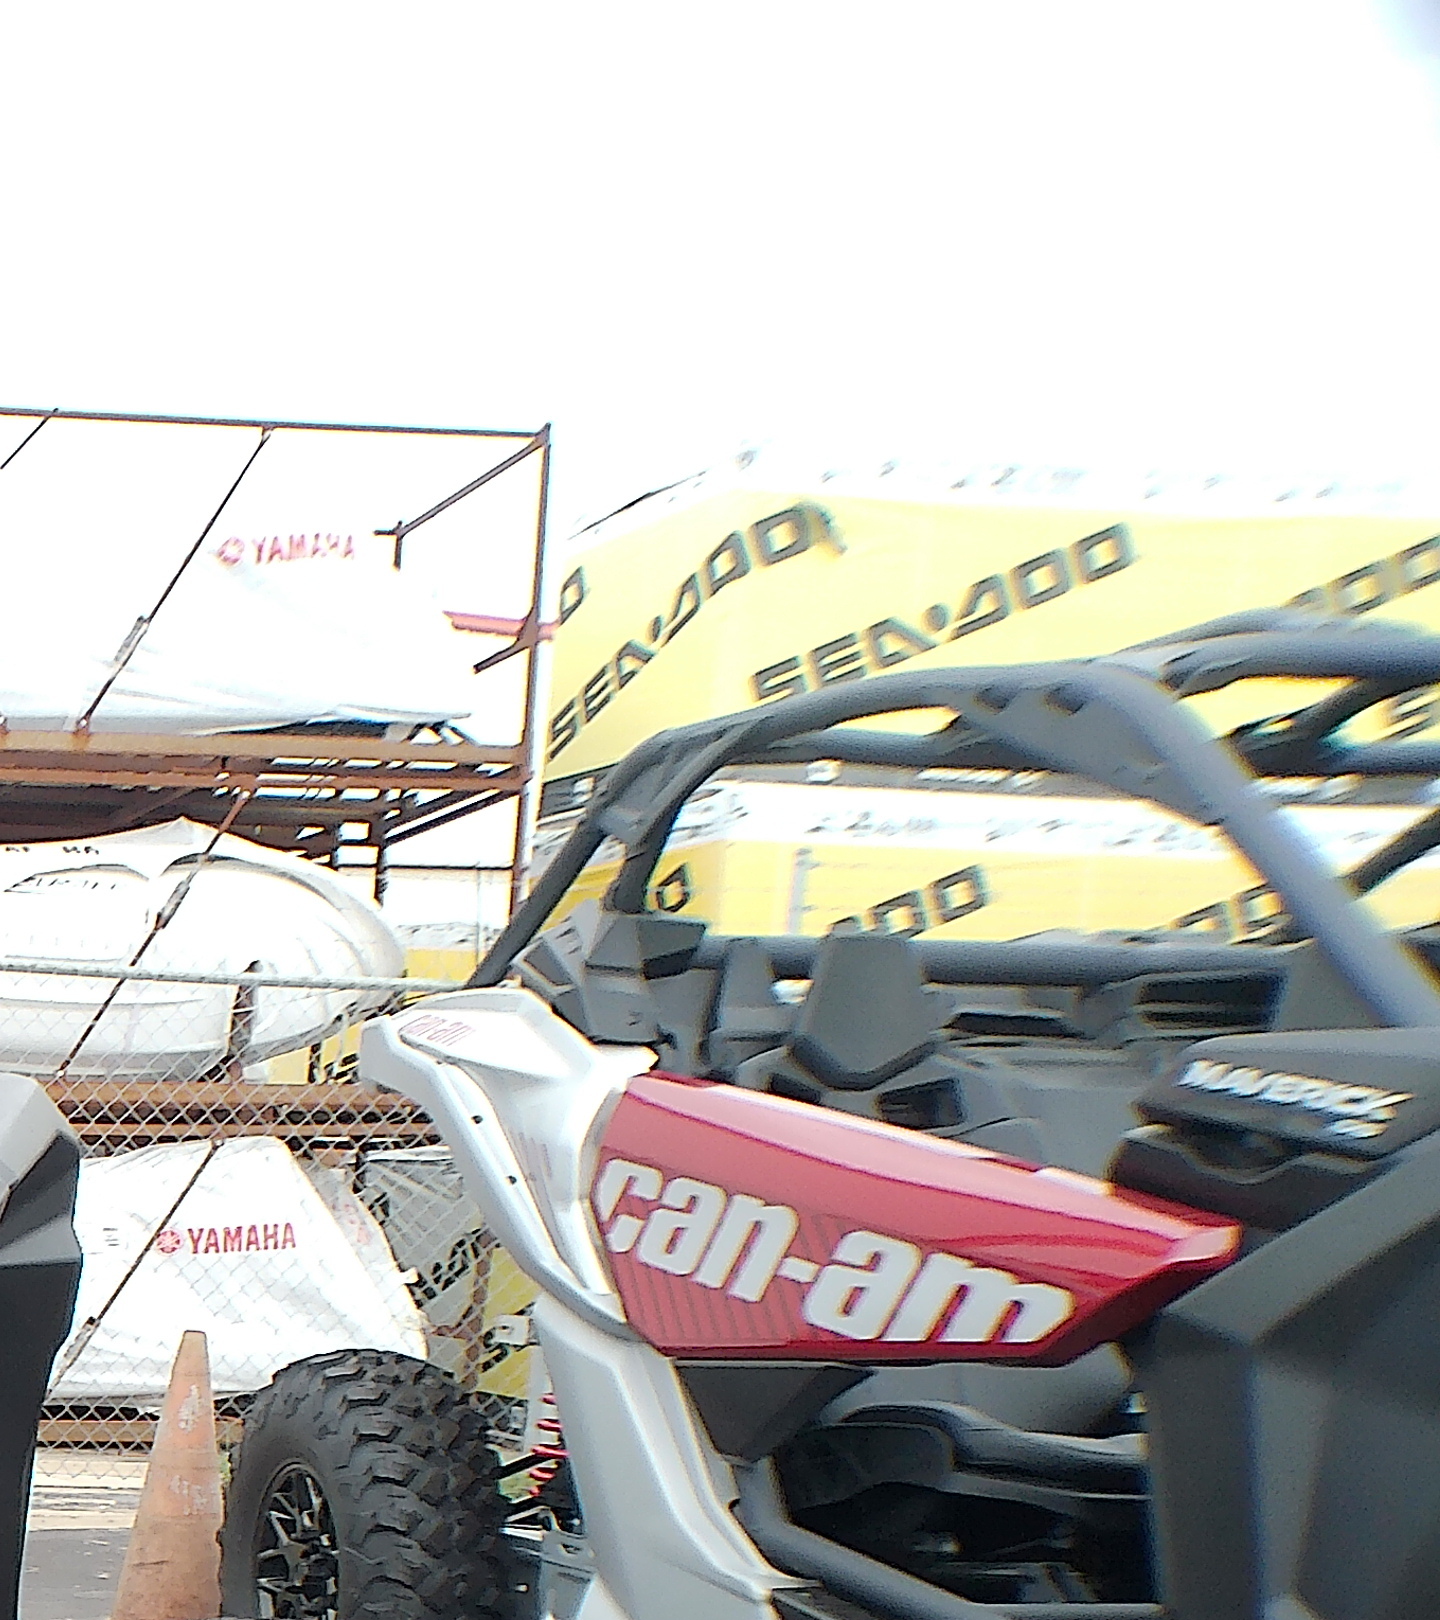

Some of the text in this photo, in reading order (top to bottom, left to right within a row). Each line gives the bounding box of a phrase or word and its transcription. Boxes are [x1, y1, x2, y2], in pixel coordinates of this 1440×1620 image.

[251, 532, 356, 565] YAMAHA
[186, 1222, 297, 1255] YAMAHA
[594, 1158, 1077, 1343] can-am
